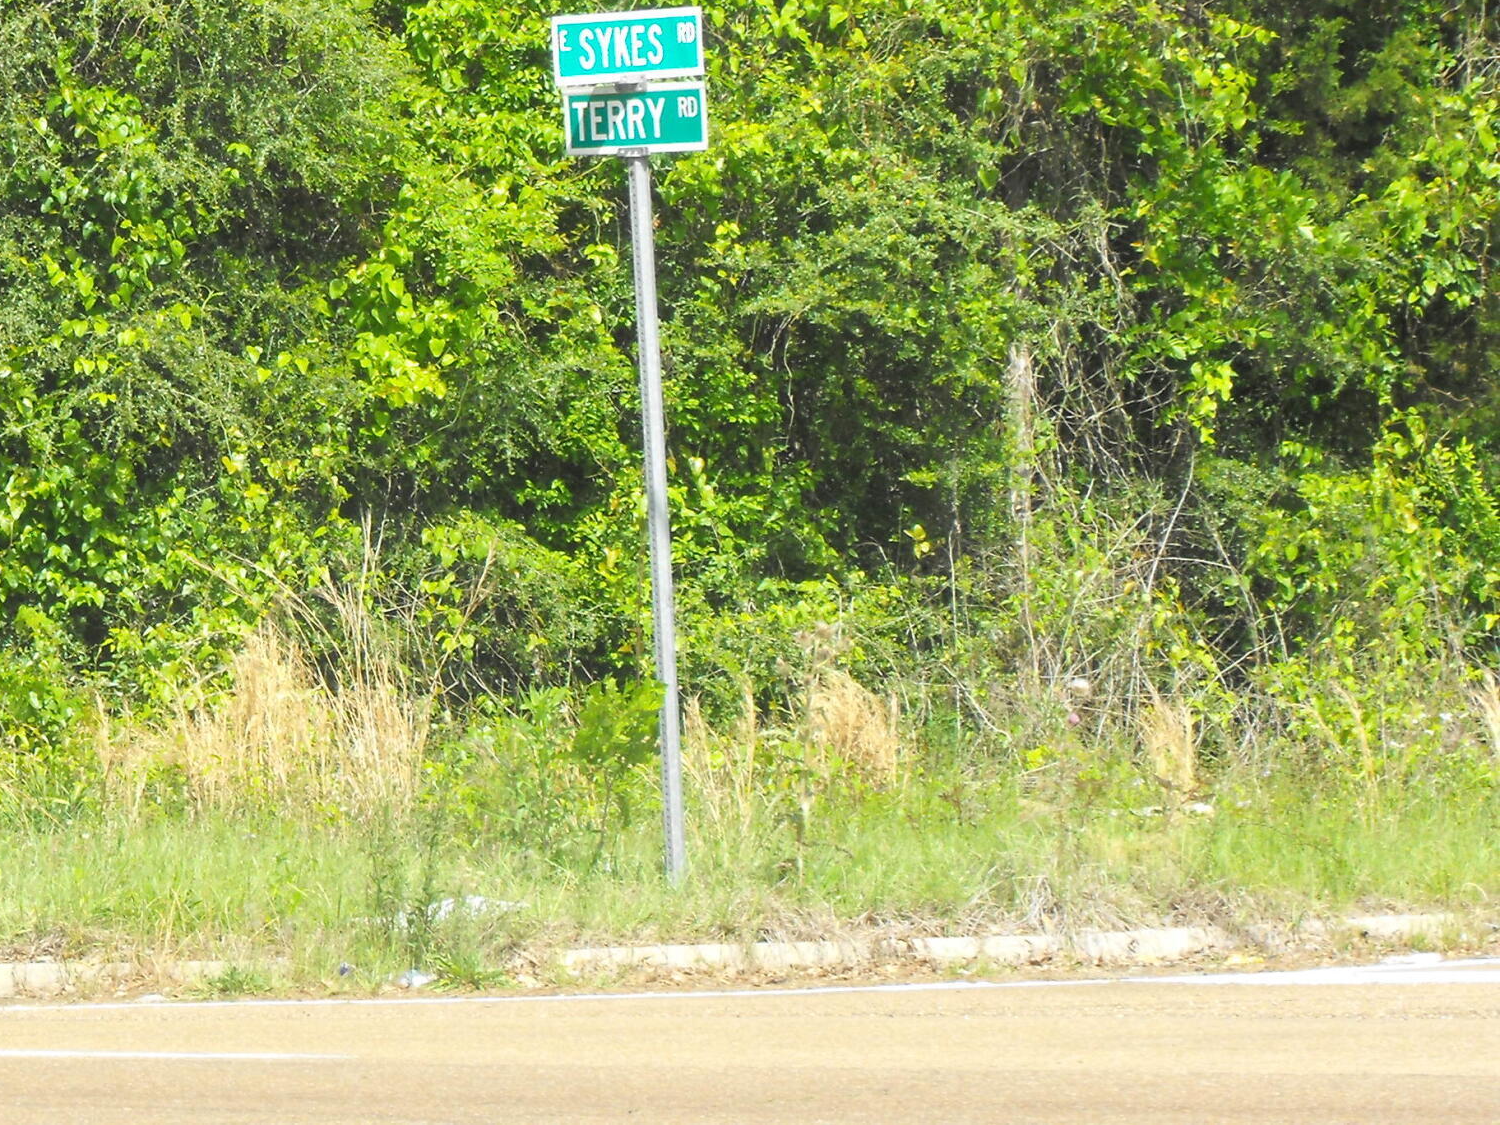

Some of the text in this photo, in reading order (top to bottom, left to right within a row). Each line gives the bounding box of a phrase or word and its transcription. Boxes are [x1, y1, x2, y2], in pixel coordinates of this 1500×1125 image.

[559, 22, 695, 70] E SYKES RD
[572, 96, 698, 141] TERRY RD
